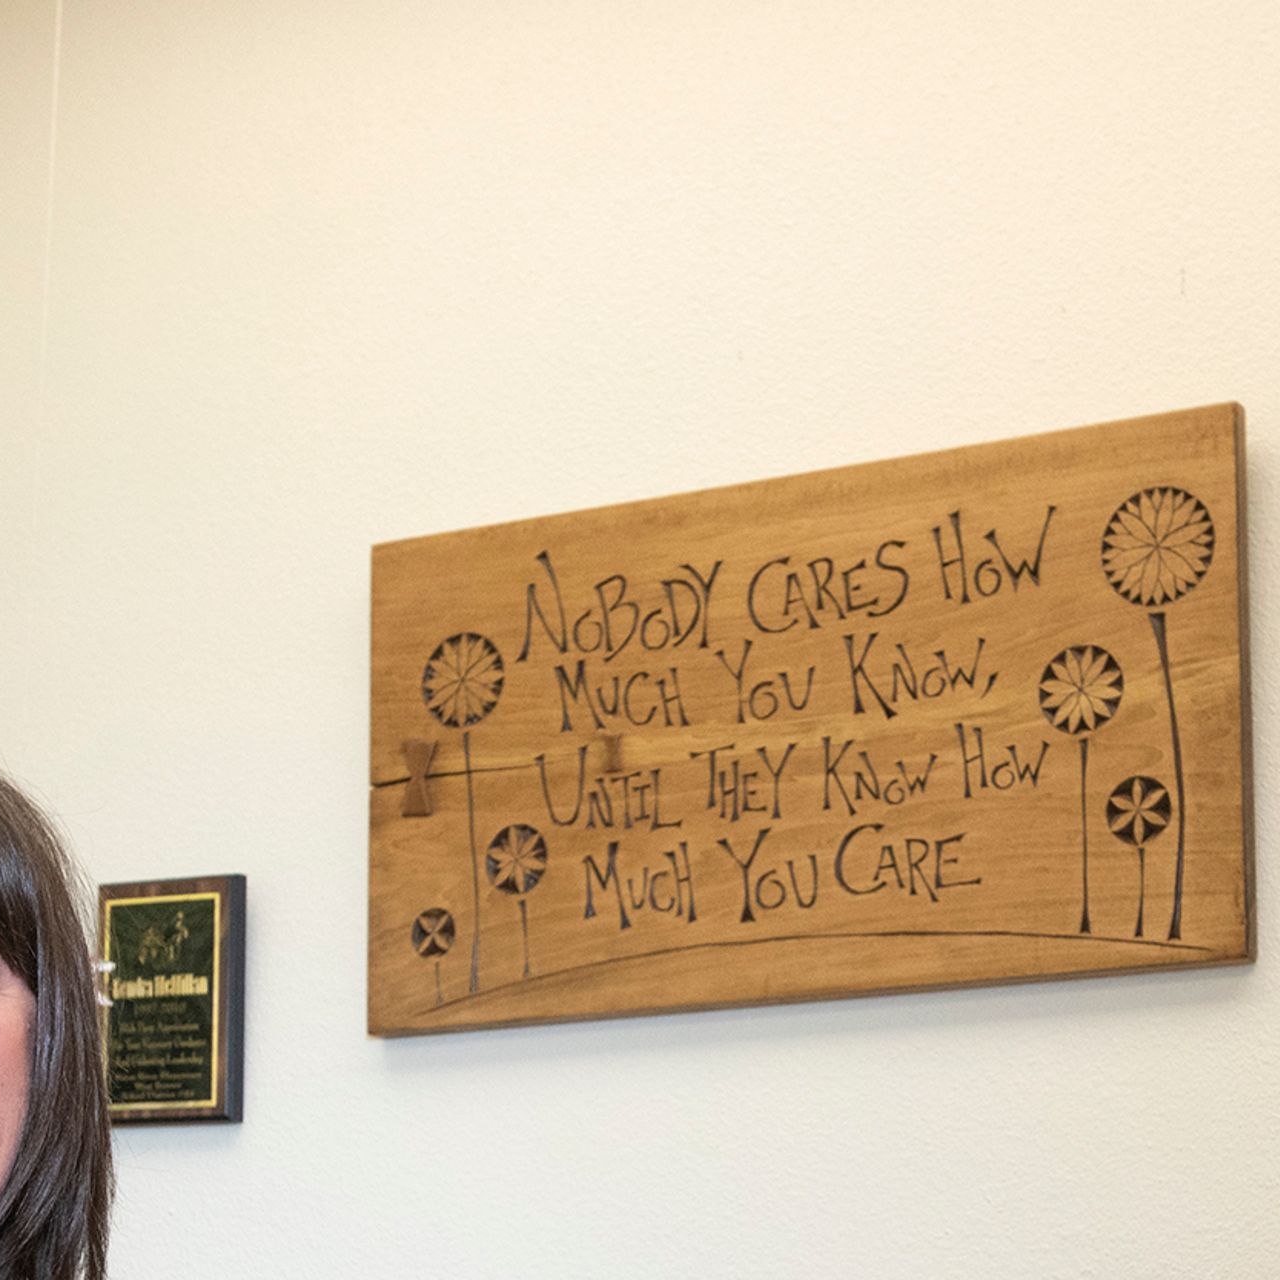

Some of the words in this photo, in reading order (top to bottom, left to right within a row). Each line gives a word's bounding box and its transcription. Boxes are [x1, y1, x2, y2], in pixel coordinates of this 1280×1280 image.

[748, 539, 910, 634] CARES
[554, 659, 690, 733] MUCH
[714, 639, 816, 723] YOU
[534, 745, 683, 831] UNTIL
[690, 743, 798, 822] THEY
[582, 841, 696, 930] MUCH
[716, 827, 818, 923] YOU
[834, 822, 982, 903] CARE
